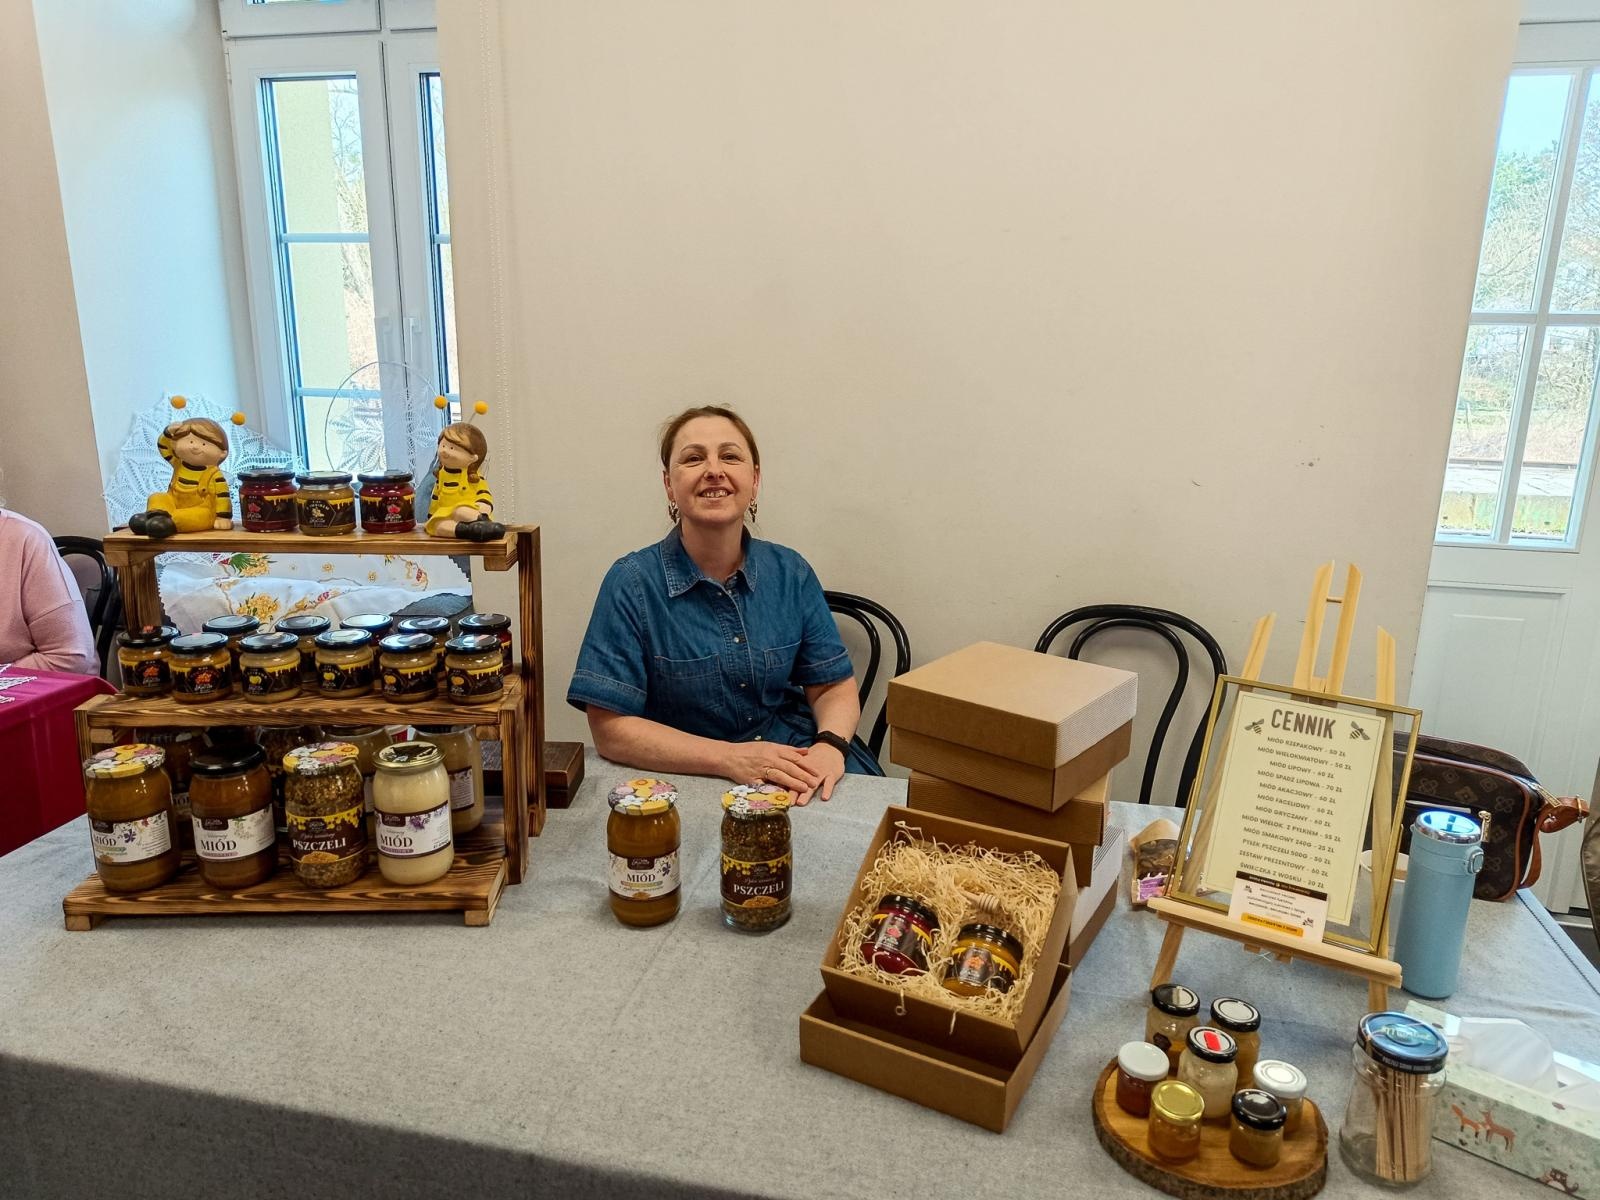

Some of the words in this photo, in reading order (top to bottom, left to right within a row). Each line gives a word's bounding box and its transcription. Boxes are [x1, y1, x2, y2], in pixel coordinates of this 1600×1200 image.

[1272, 709, 1336, 739] CENNIK
[1286, 741, 1323, 752] RZEPAKOWY
[1276, 751, 1328, 765] WIELOKWIATOWY
[1288, 765, 1311, 773] LIPOWY
[1296, 778, 1321, 788] LIPOWA
[1278, 786, 1313, 798] AKACJOWY
[1276, 798, 1311, 810] FACELIOWY
[1274, 810, 1308, 822] GRYCZANY
[380, 834, 412, 848] MIÓD
[1261, 831, 1294, 843] SMAKOWY
[200, 838, 236, 852] MIÓD
[292, 837, 346, 850] PSZCZELI
[1240, 850, 1263, 860] ZESTAW
[1264, 856, 1306, 870] PREZENTOWY
[626, 873, 656, 882] MIÓD
[1278, 872, 1302, 882] WOSKU
[734, 880, 784, 896] PSZCZELI
